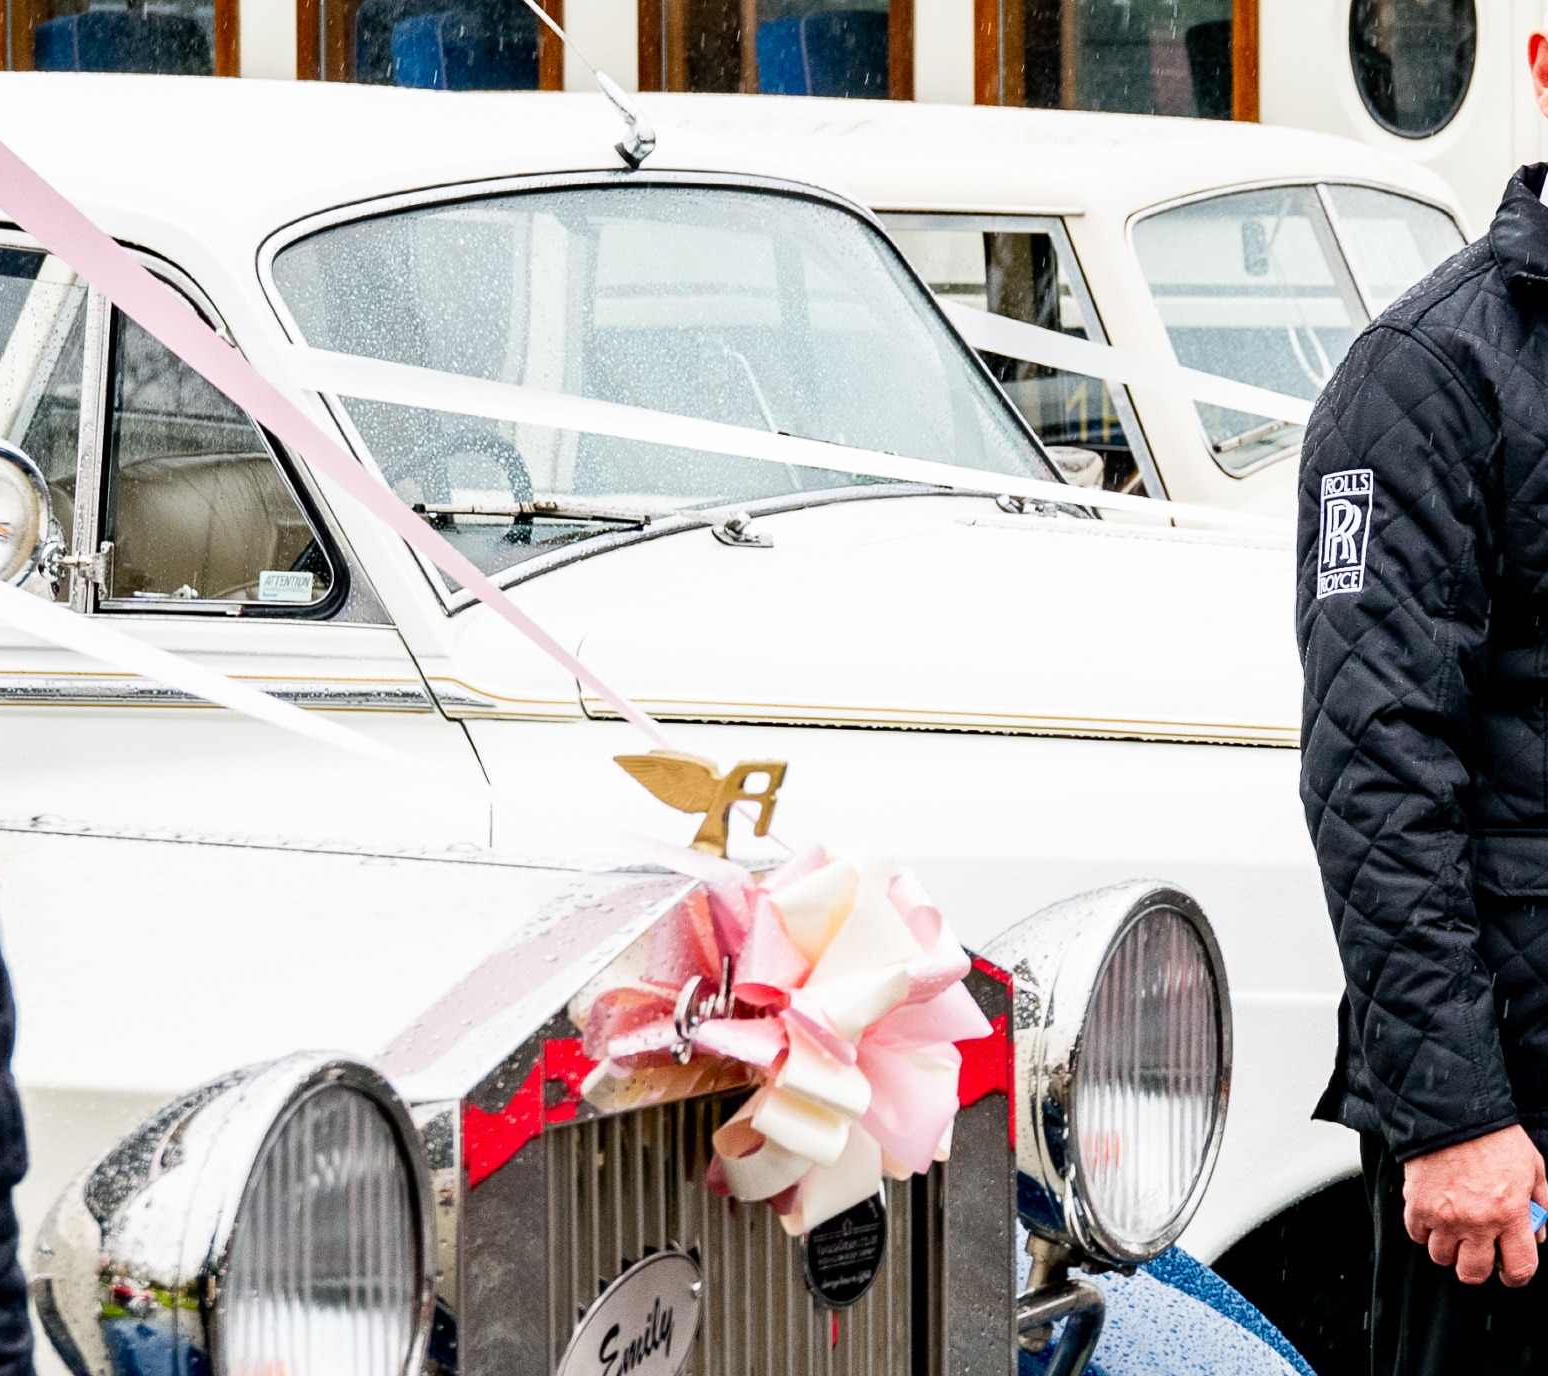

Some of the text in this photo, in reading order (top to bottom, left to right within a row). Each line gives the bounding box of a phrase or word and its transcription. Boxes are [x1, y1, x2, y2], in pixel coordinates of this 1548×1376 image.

[1326, 473, 1369, 495] ROLLS
[265, 575, 311, 587] ATTENTION
[1320, 571, 1360, 593] ROYCE
